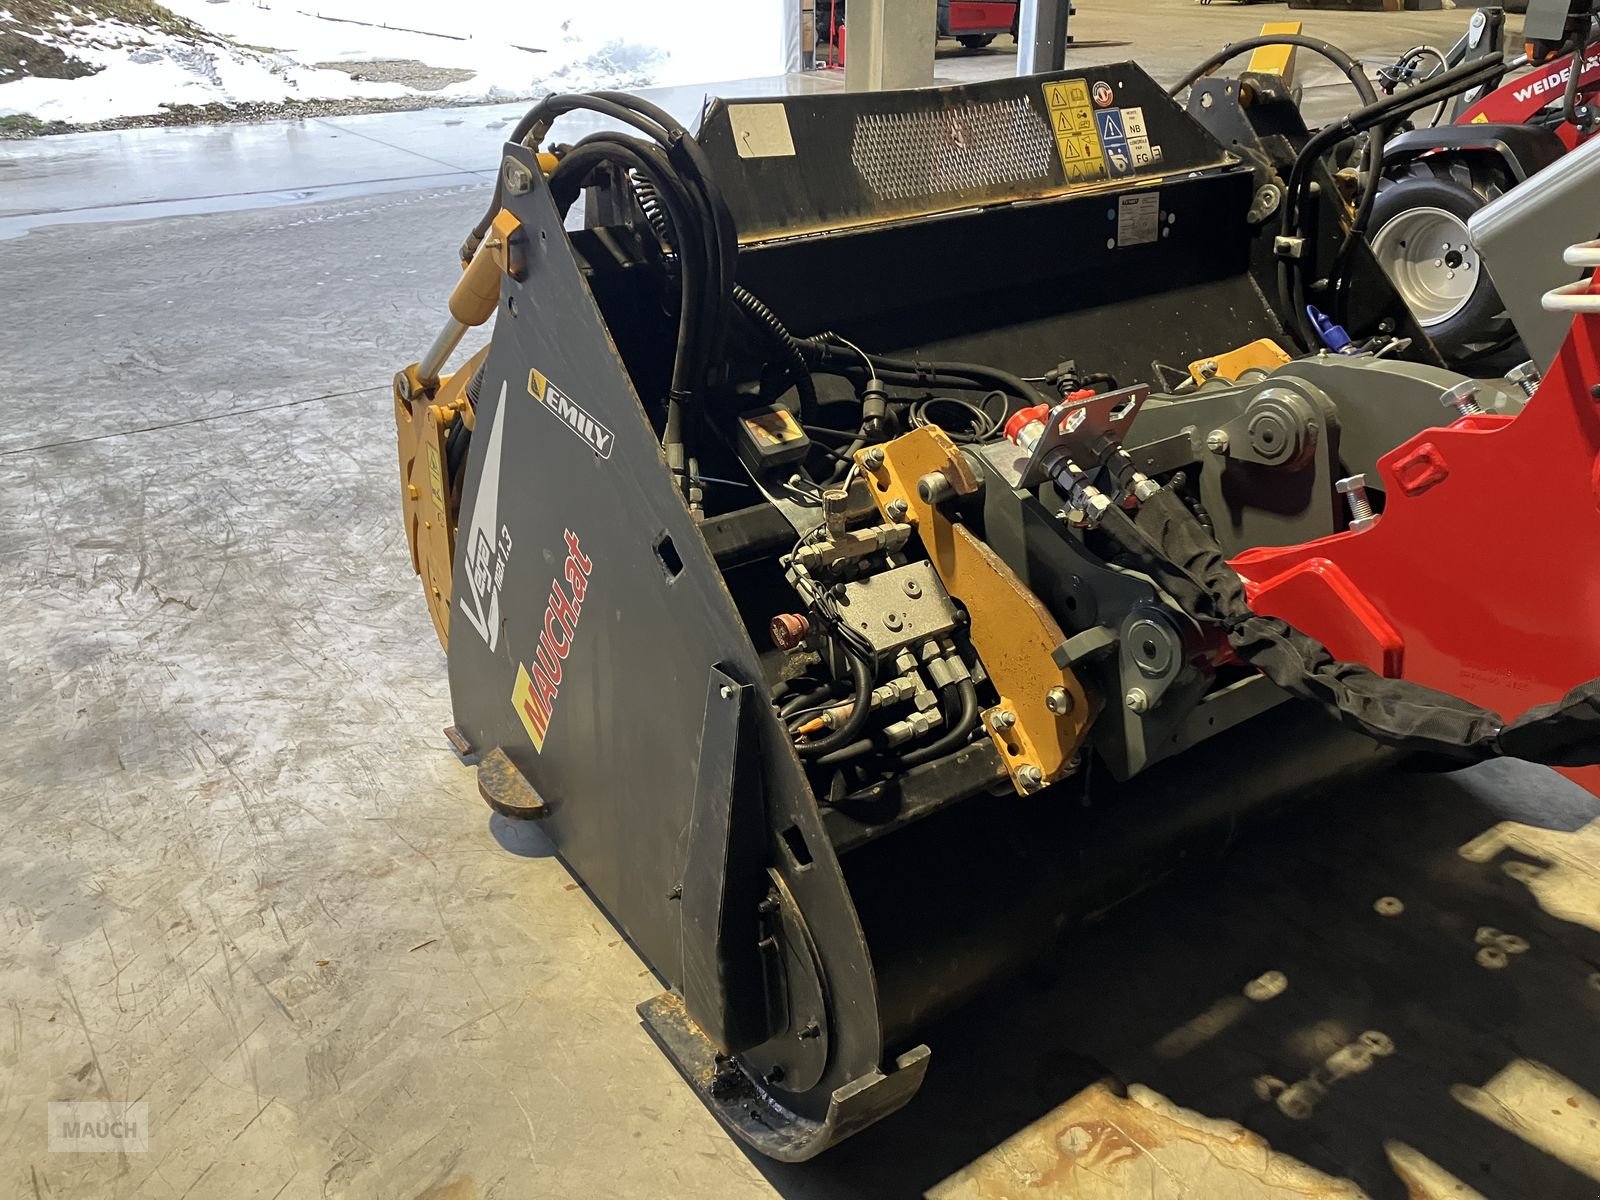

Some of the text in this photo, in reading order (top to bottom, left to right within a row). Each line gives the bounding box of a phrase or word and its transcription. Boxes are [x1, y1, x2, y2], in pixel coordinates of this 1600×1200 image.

[1129, 124, 1141, 134] NB
[1136, 153, 1149, 163] FG
[546, 387, 610, 451] EMILY
[523, 527, 593, 742] MAUCH.at
